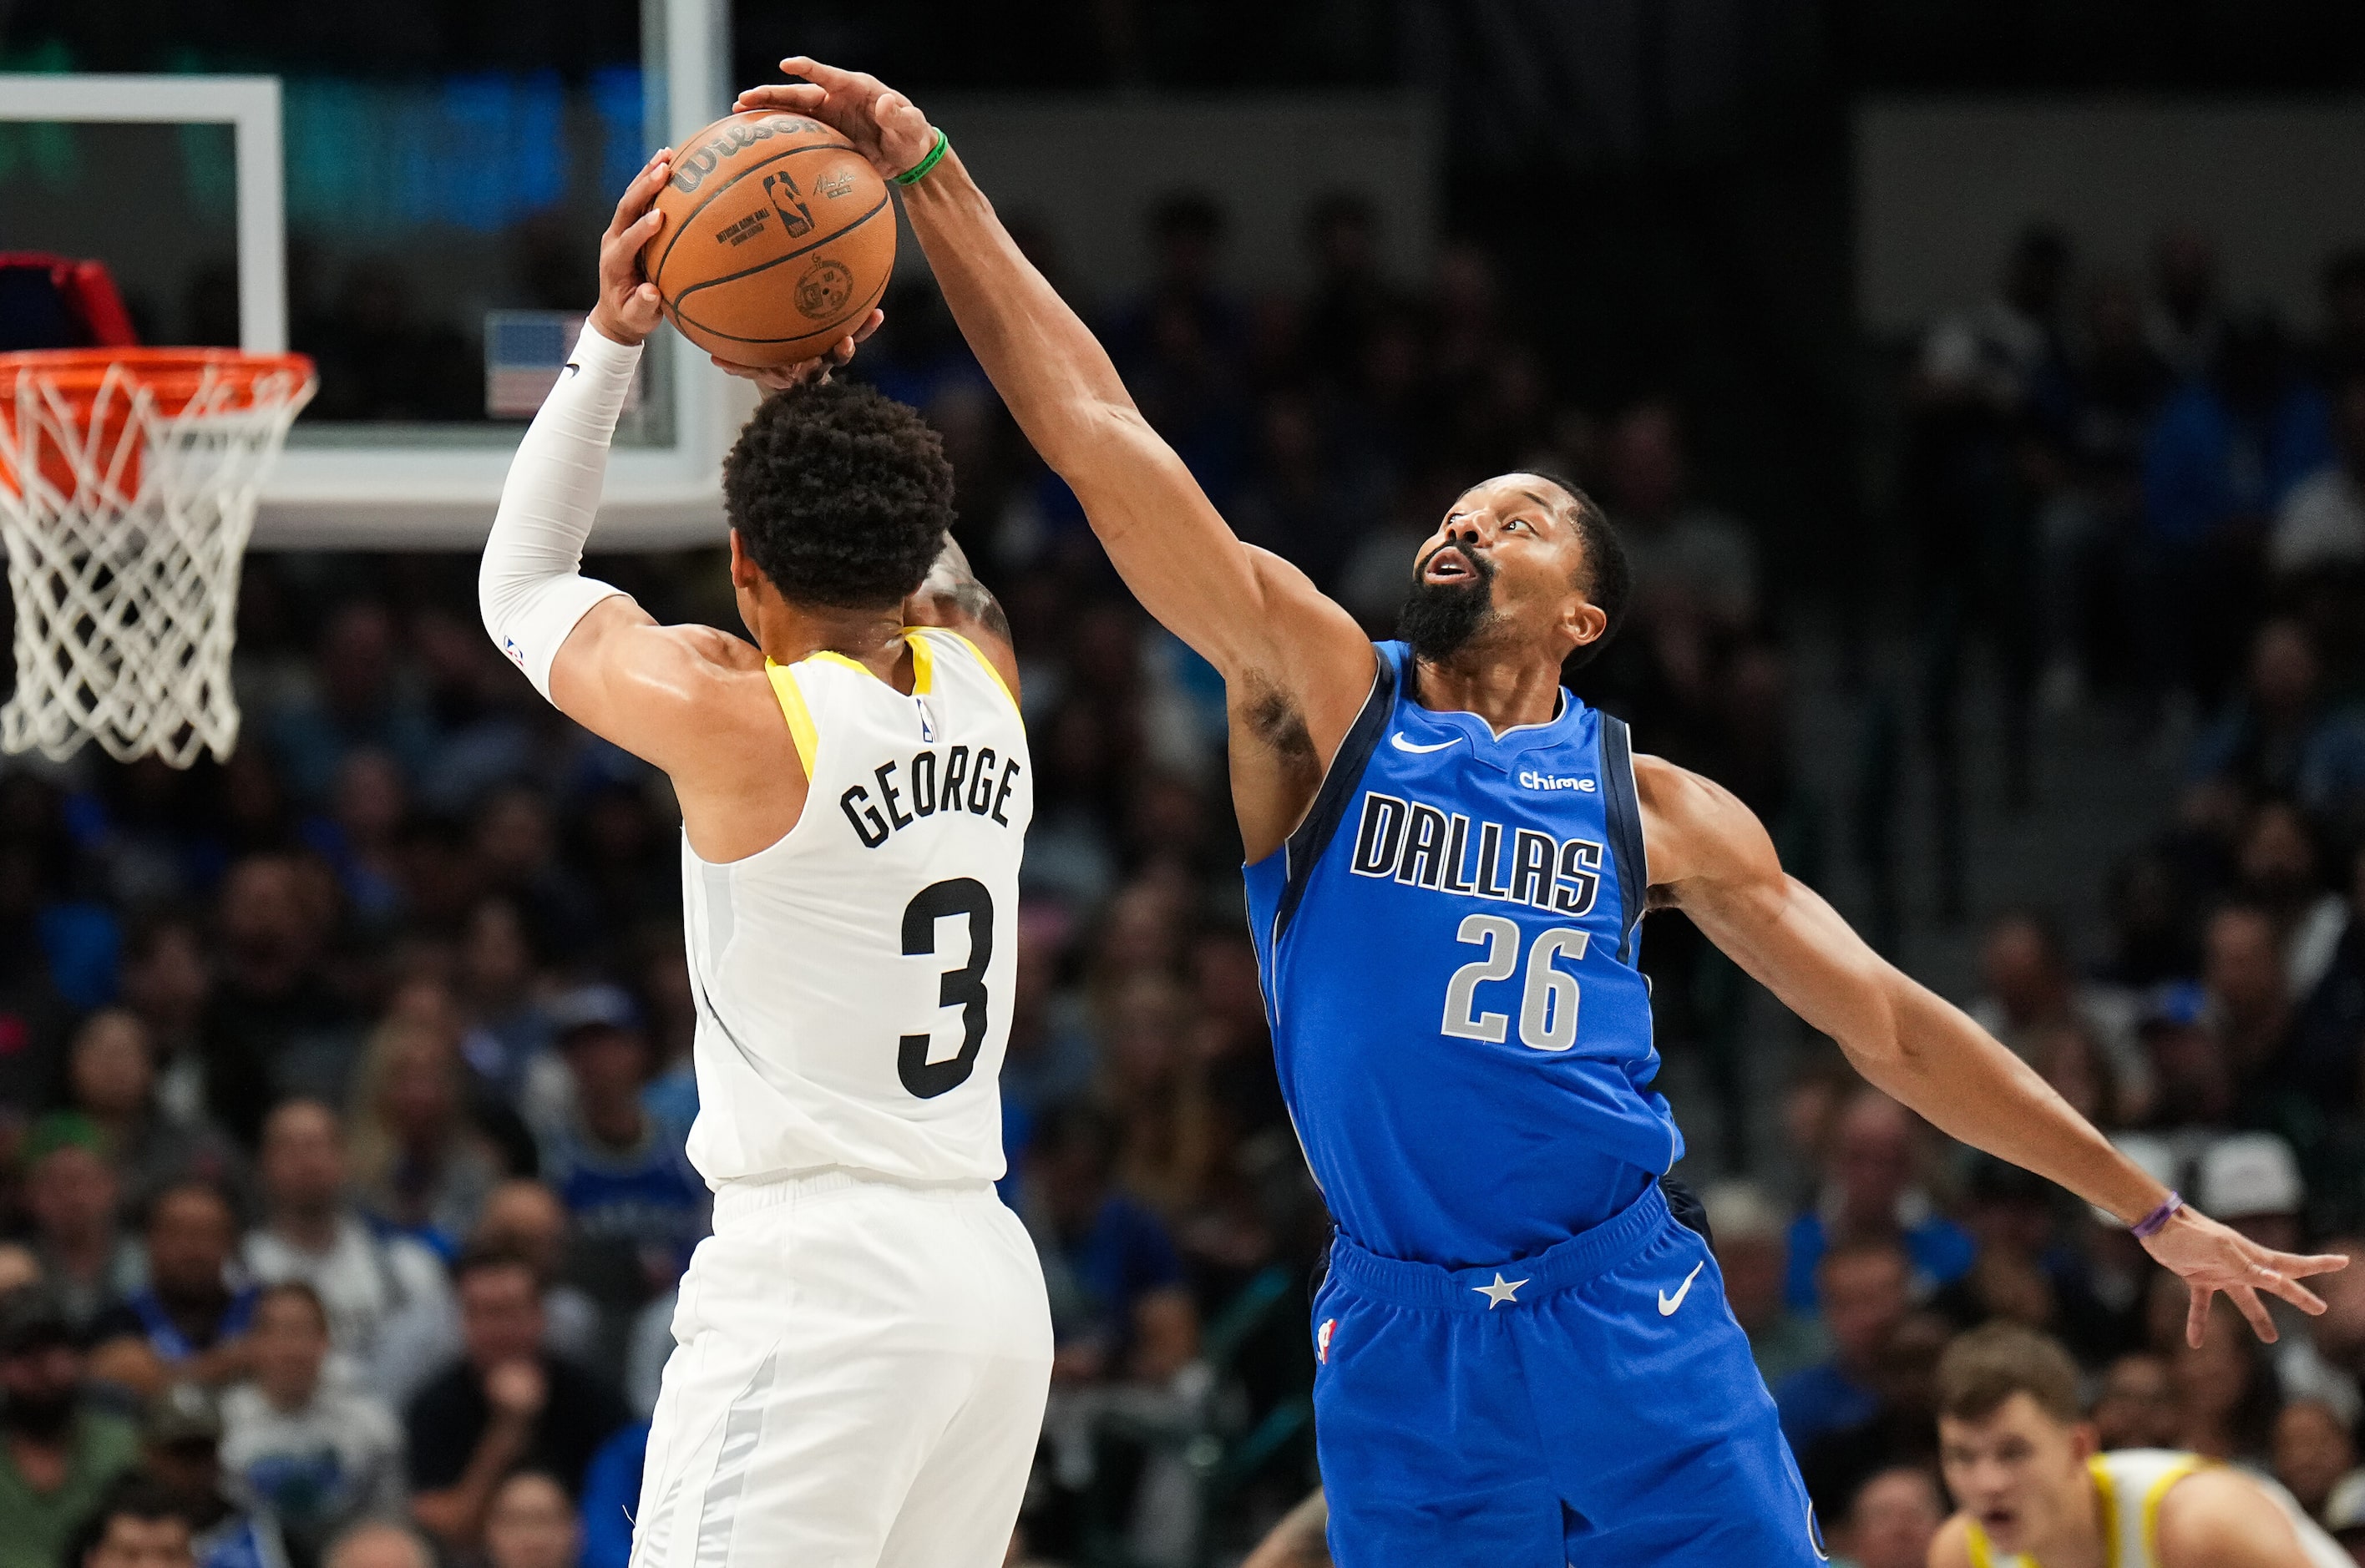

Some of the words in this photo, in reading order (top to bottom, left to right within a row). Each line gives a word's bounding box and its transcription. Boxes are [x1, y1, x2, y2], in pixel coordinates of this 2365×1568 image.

[840, 746, 1020, 848] GEORGE
[1350, 791, 1603, 918] DALLAS
[898, 877, 994, 1099] 3
[1441, 913, 1590, 1051] 26
